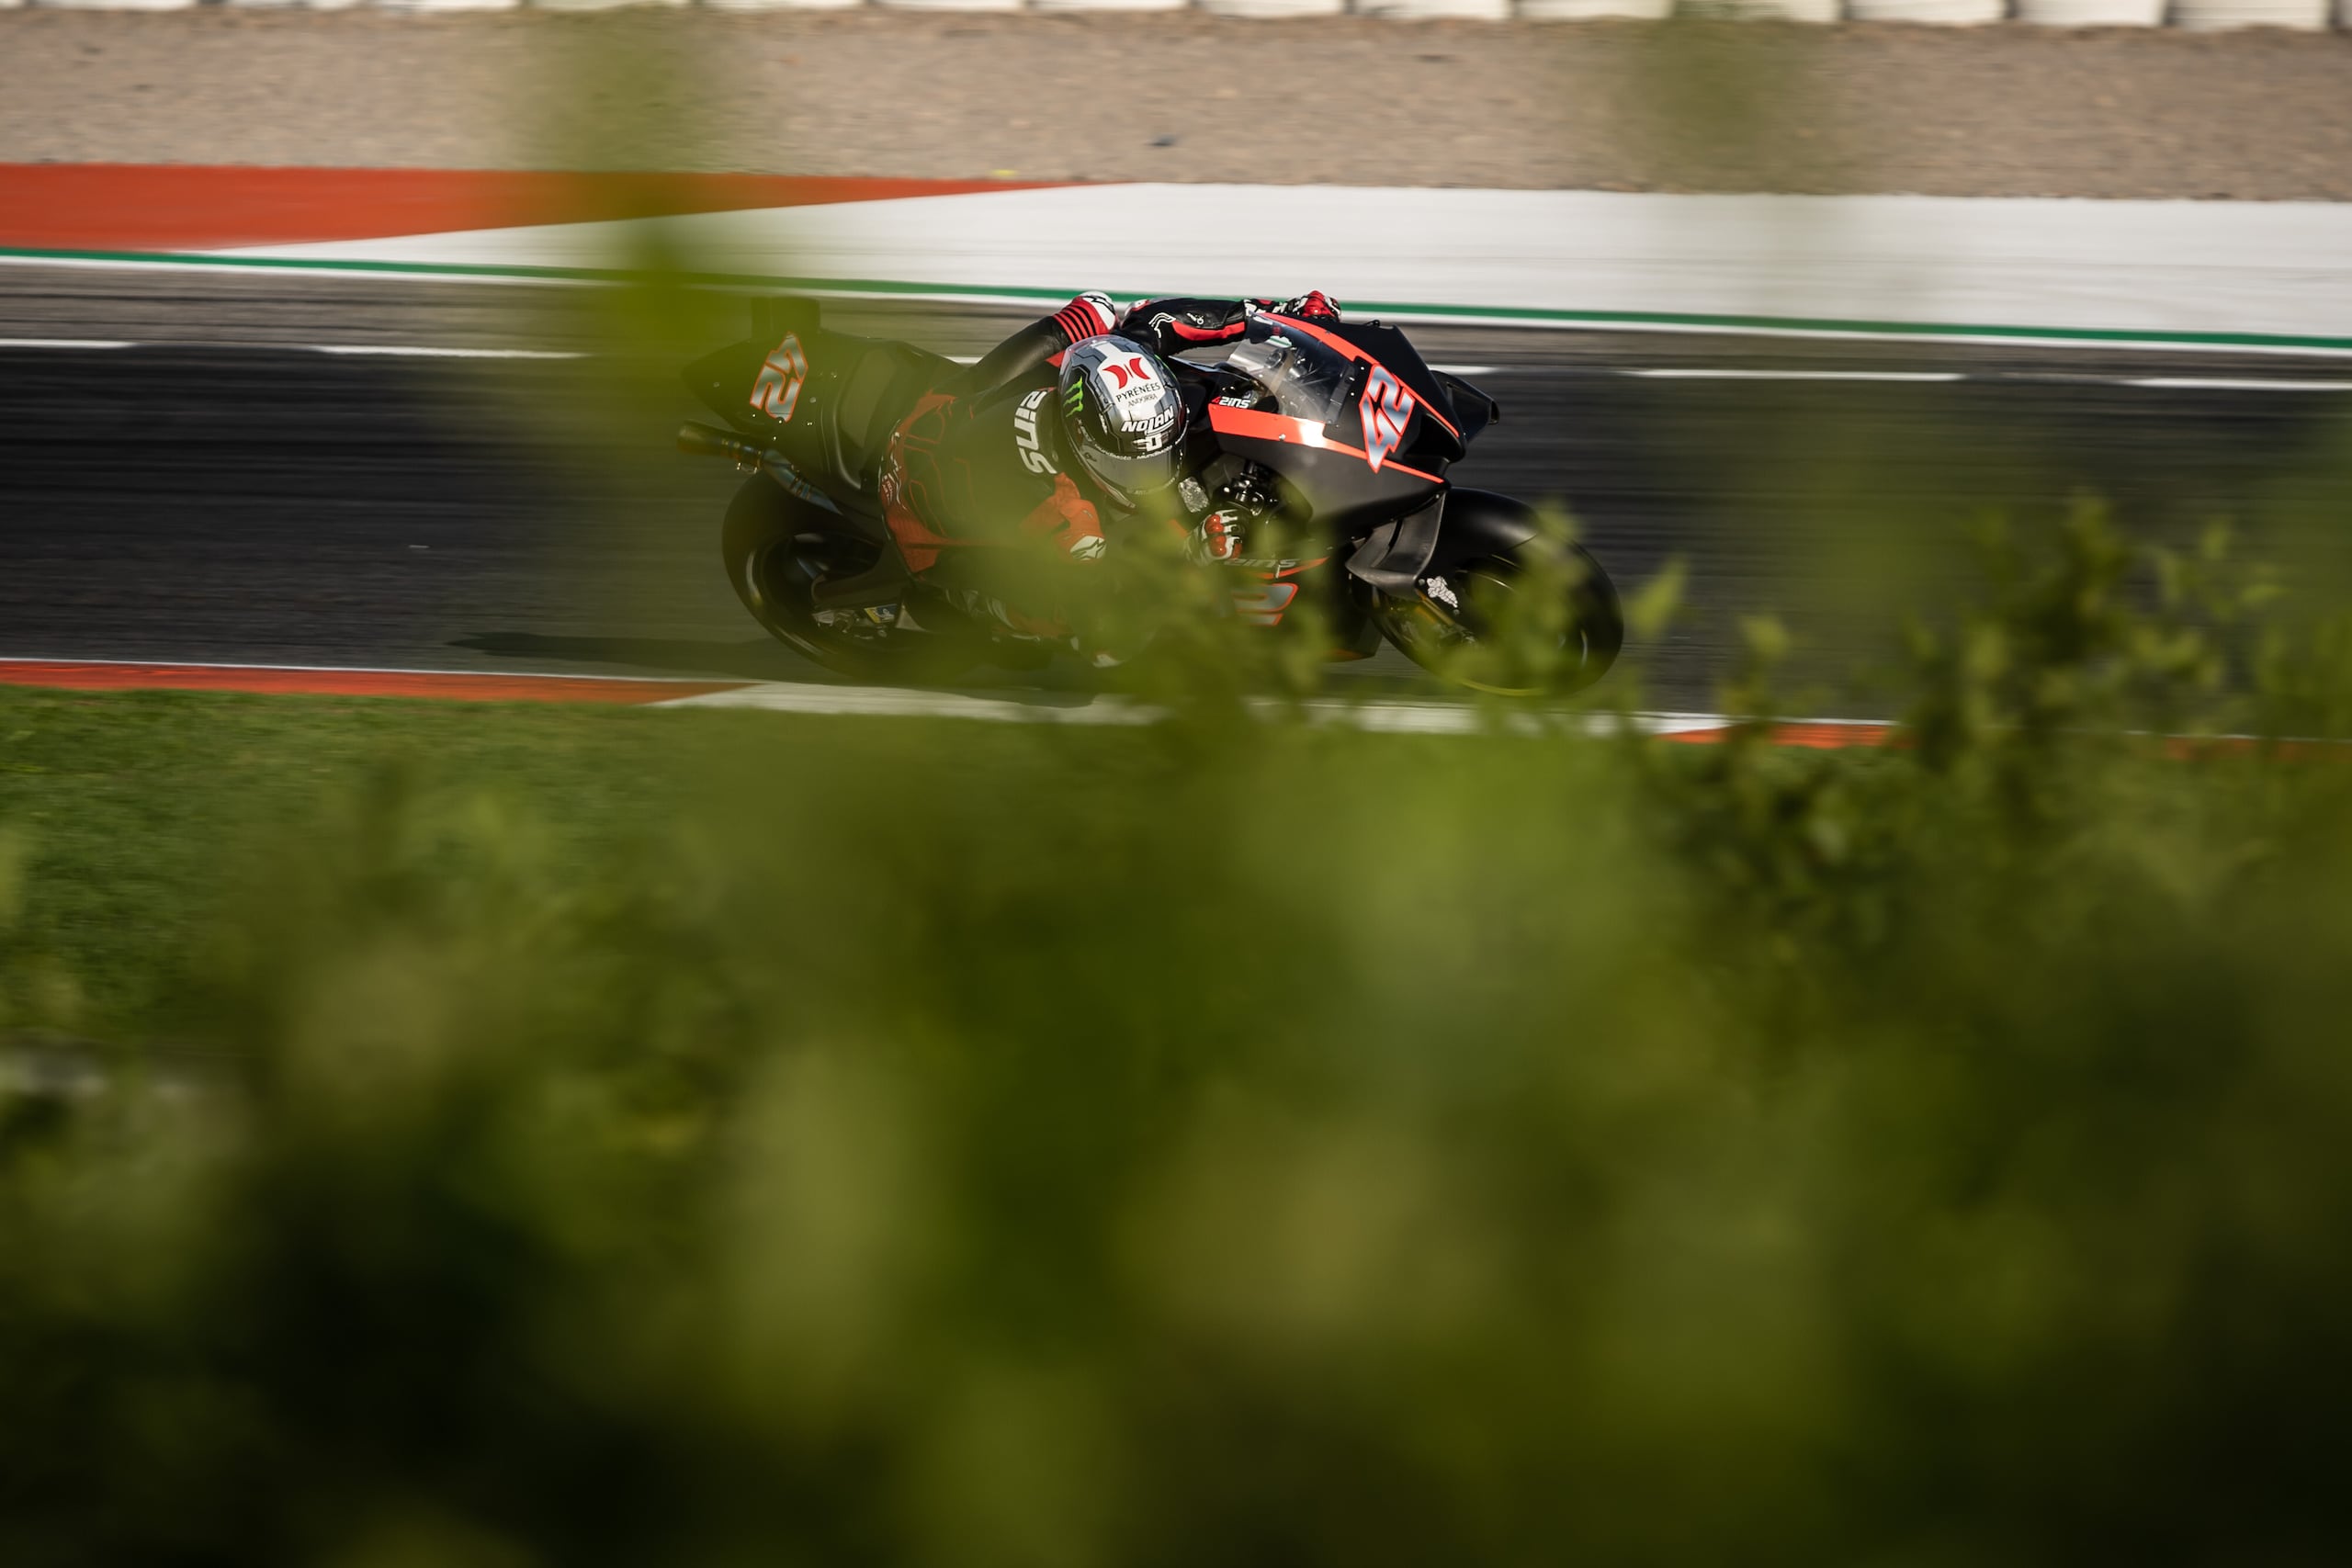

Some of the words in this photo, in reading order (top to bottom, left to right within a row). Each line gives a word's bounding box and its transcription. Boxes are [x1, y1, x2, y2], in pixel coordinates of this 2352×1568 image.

[750, 331, 808, 423] 42
[1121, 405, 1174, 435] NOLAN
[1359, 363, 1415, 474] 42
